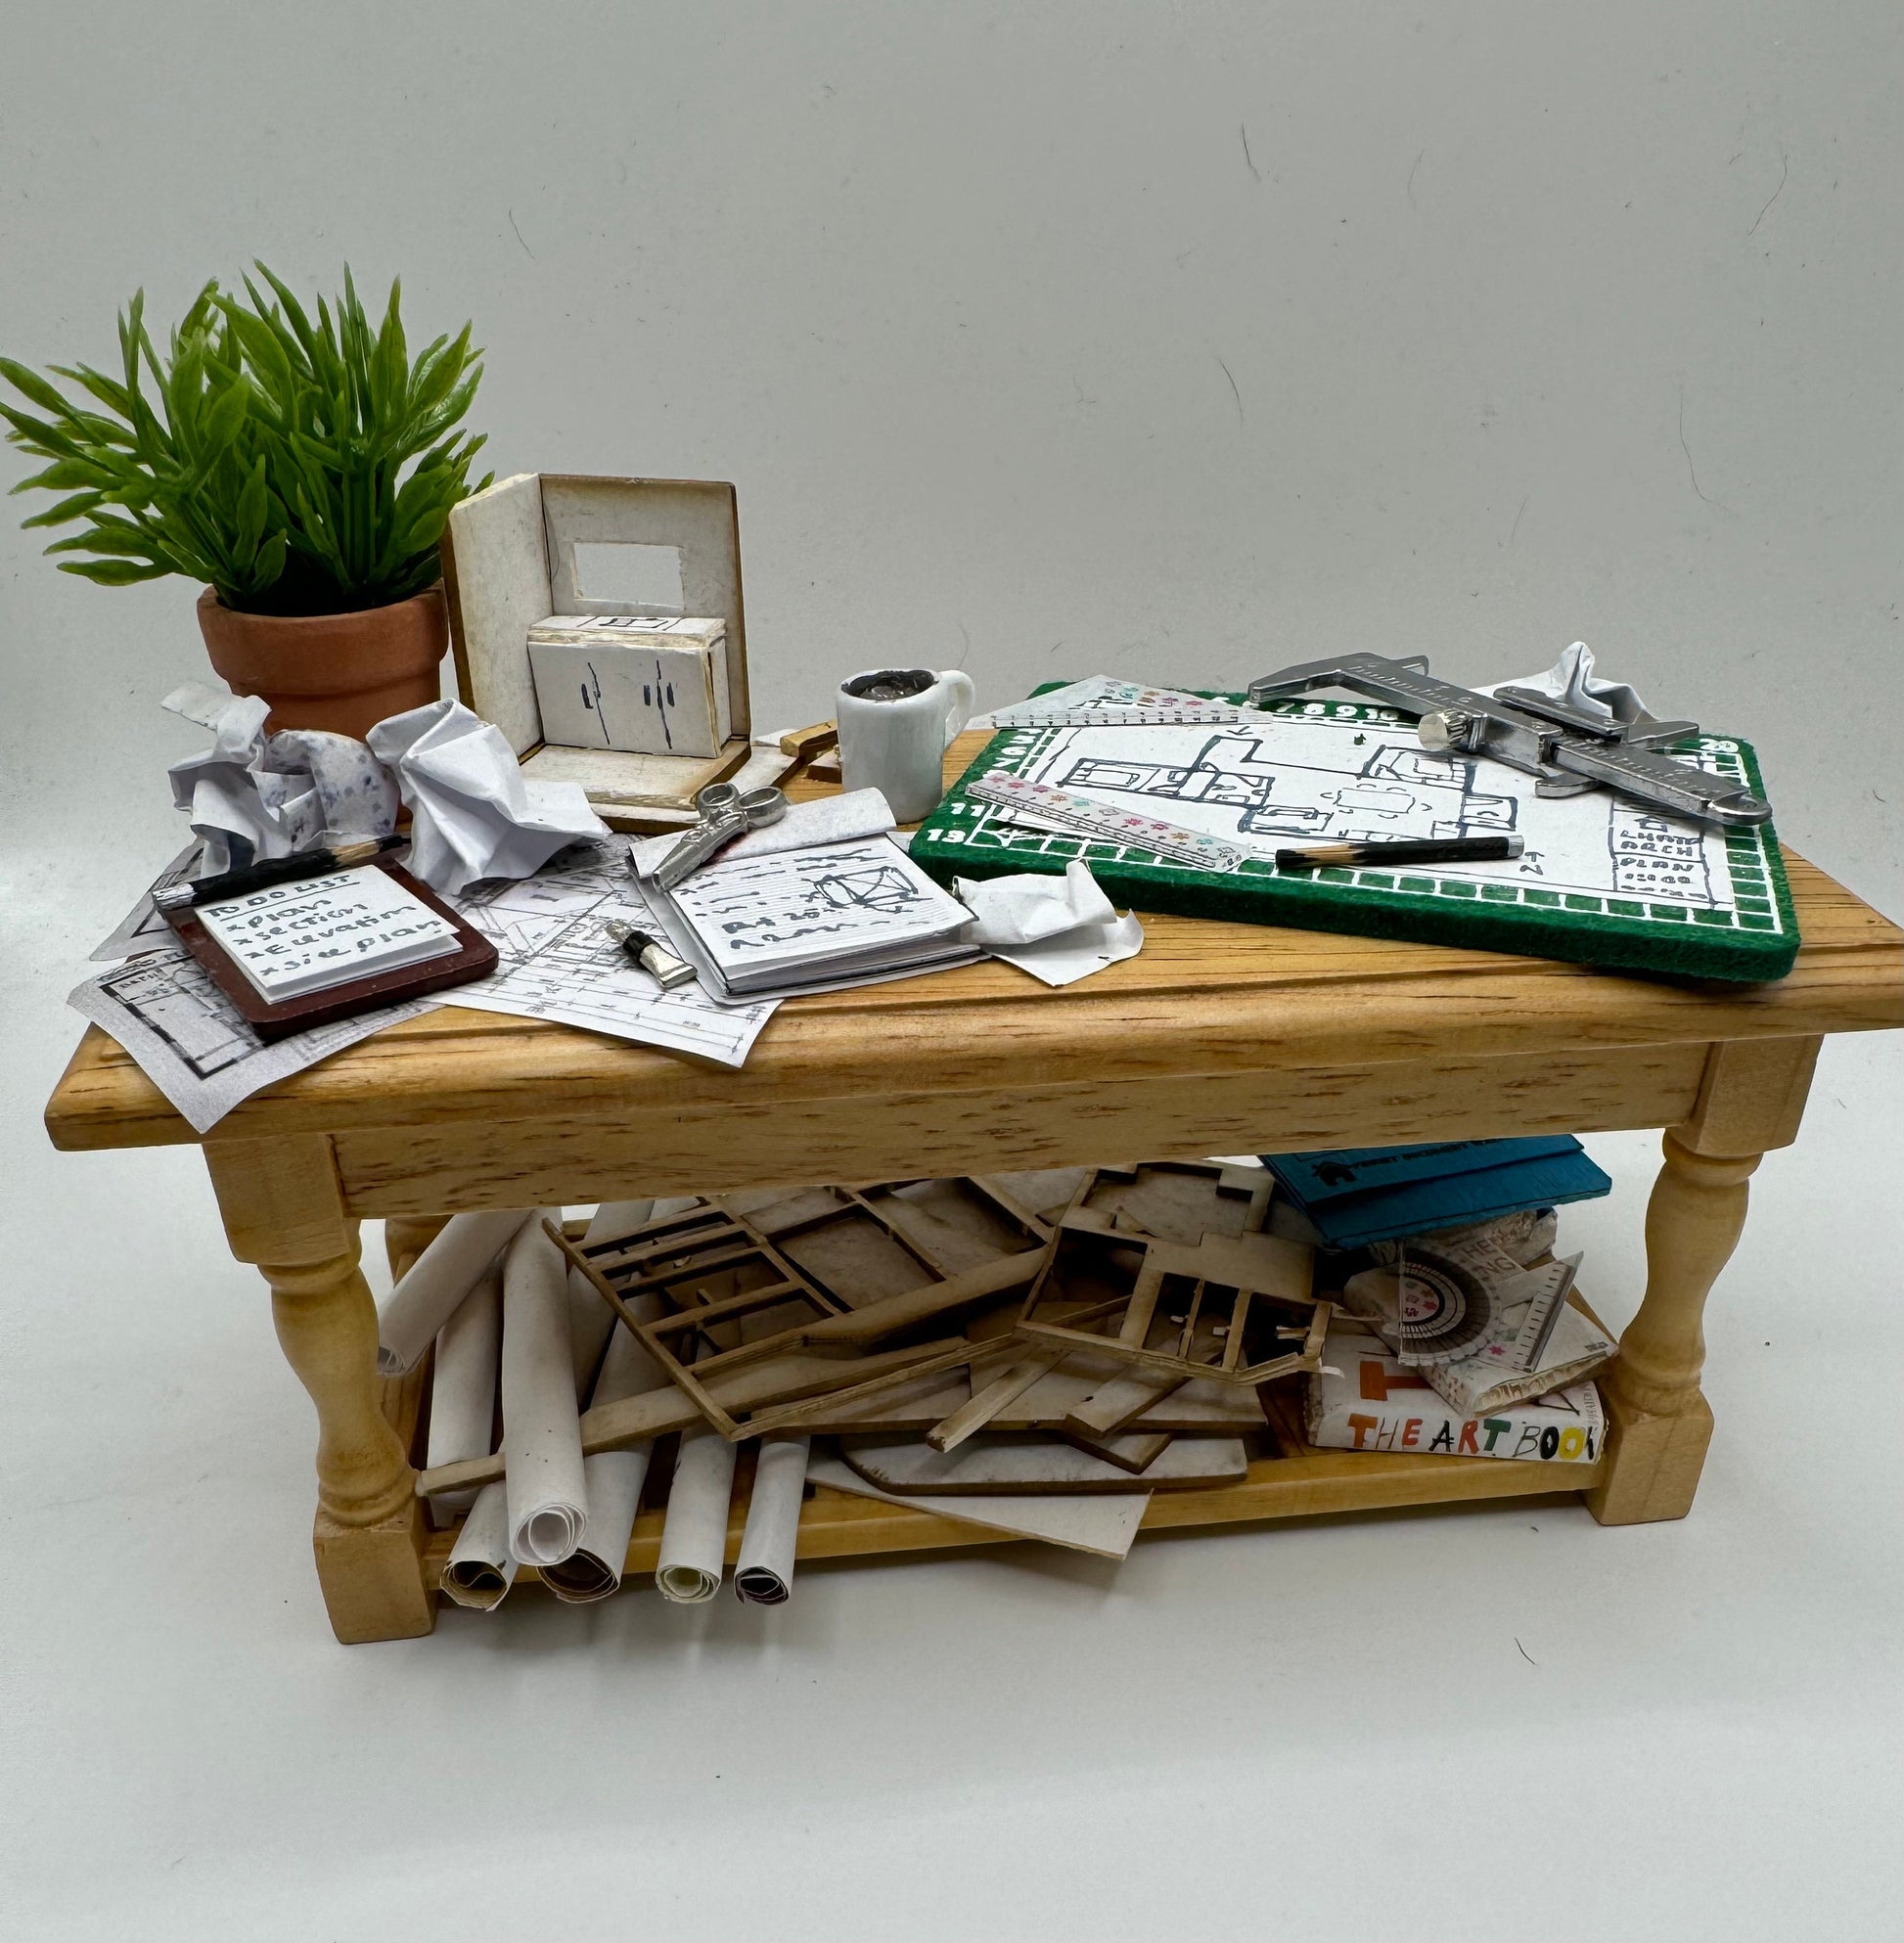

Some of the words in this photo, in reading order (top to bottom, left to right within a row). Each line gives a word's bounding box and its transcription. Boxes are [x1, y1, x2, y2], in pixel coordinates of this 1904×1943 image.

[247, 891, 286, 907] DO
[1346, 1413, 1424, 1450] THE
[1428, 1419, 1512, 1455] ART
